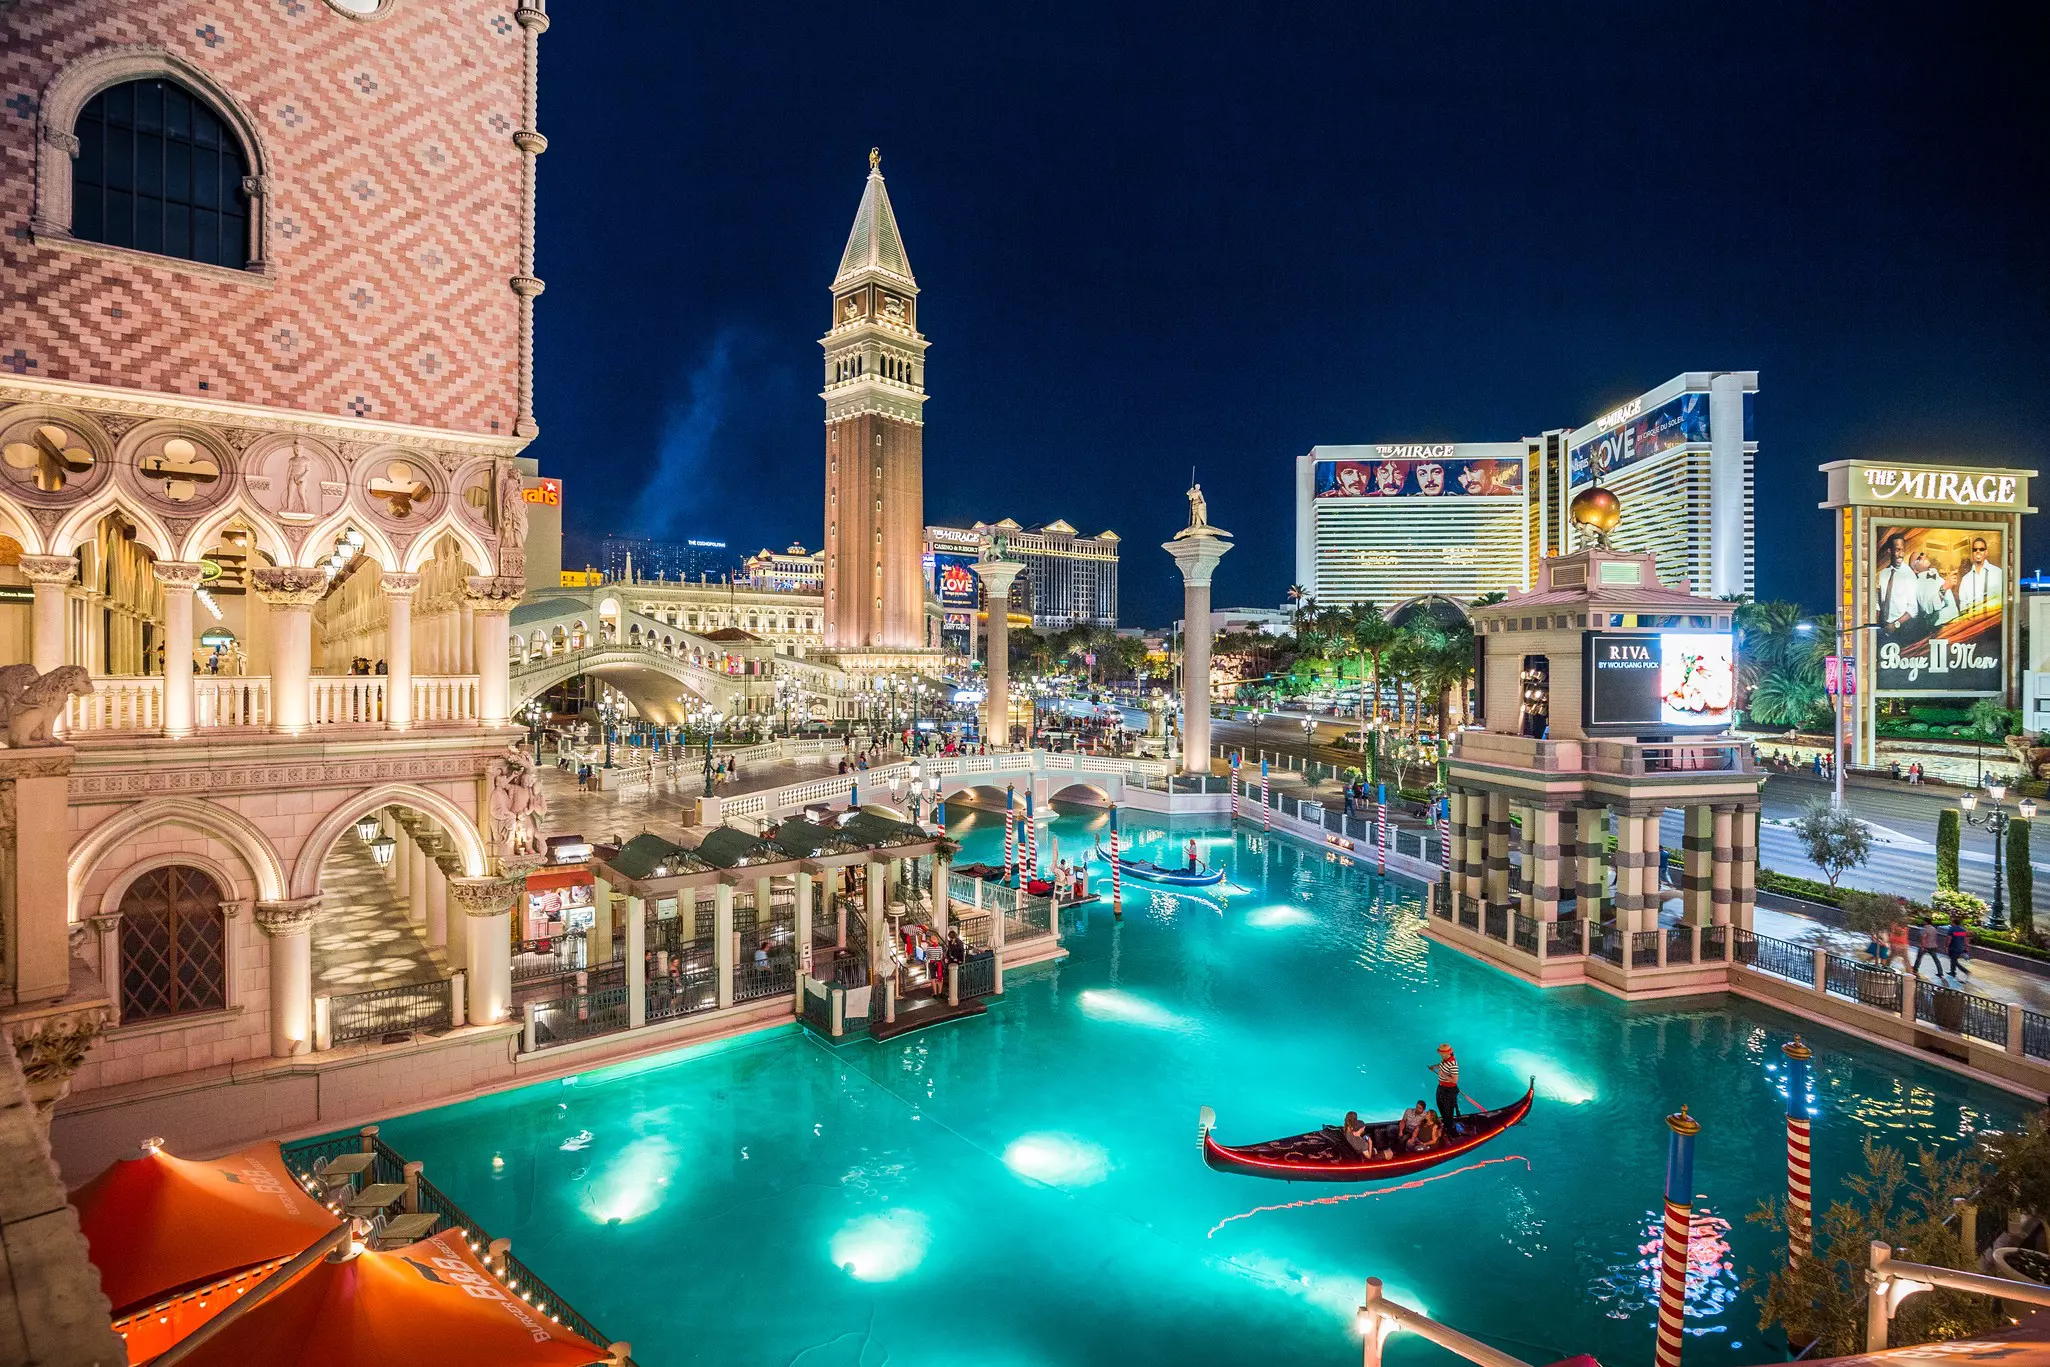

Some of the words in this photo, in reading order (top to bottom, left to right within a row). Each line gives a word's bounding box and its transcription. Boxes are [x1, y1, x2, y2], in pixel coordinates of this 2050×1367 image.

[1660, 423, 1668, 431] DU
[1376, 446, 1393, 454] THE
[1381, 445, 1454, 459] MIRAGE
[1597, 428, 1636, 469] OVE
[1864, 469, 1897, 485] THE
[1872, 471, 2016, 505] MIRAGE
[935, 531, 980, 543] MIRAGE
[934, 543, 953, 551] CASINO
[940, 578, 974, 593] LOVE
[1609, 646, 1650, 660] RIVA
[1928, 639, 1949, 673] II
[1949, 643, 1998, 669] Men
[1608, 661, 1642, 669] WOLFGANG
[1643, 661, 1659, 669] PUCK
[240, 1170, 287, 1194] B&B
[431, 1257, 509, 1301] B&B
[501, 1301, 551, 1343] BURGER
